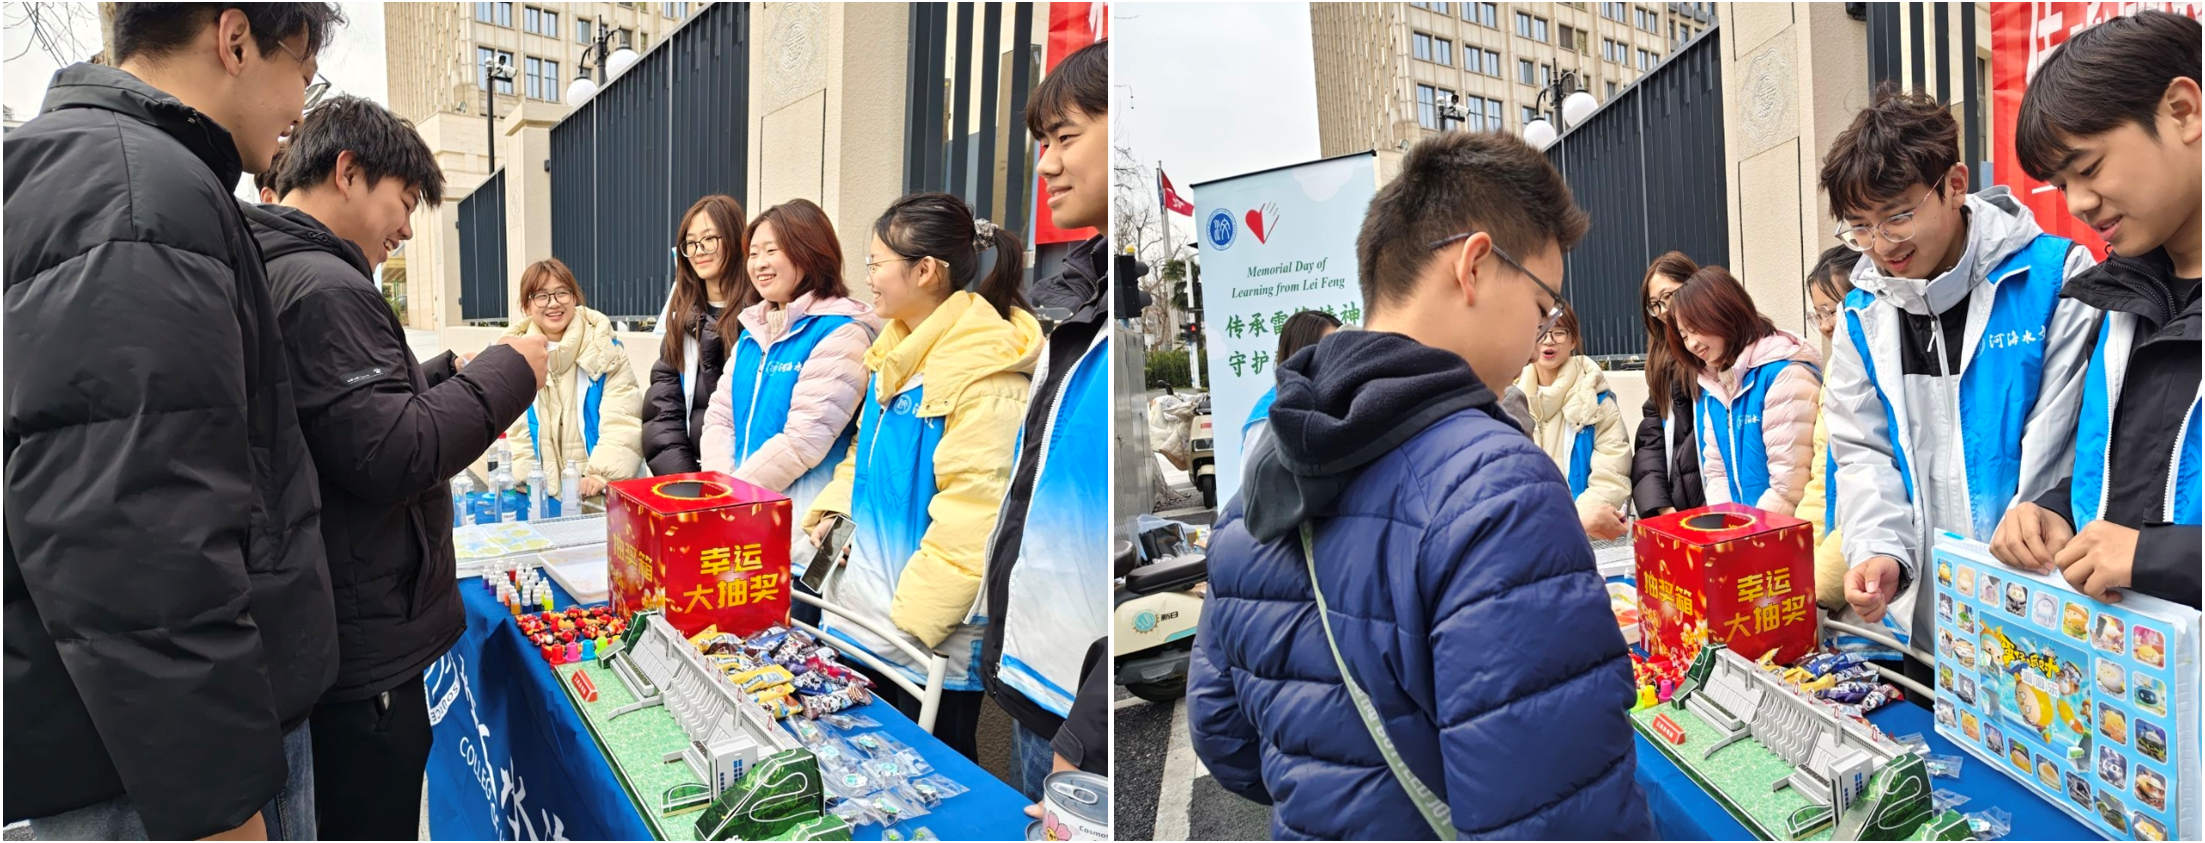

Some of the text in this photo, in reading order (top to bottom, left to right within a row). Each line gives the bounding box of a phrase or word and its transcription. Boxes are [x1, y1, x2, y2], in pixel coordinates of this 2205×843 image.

[1247, 257, 1328, 278] Memorial Day of
[1232, 276, 1345, 299] Learning from Lei Feng
[1225, 301, 1361, 340] 传承雷神
[1228, 350, 1278, 378] 守护
[613, 533, 653, 583] 抽奖箱
[700, 543, 763, 576] 幸运
[683, 573, 779, 614] 大抽奖
[1643, 571, 1693, 616] 抽奖箱
[1737, 567, 1792, 603] 幸运
[1724, 595, 1807, 643] 大抽奖
